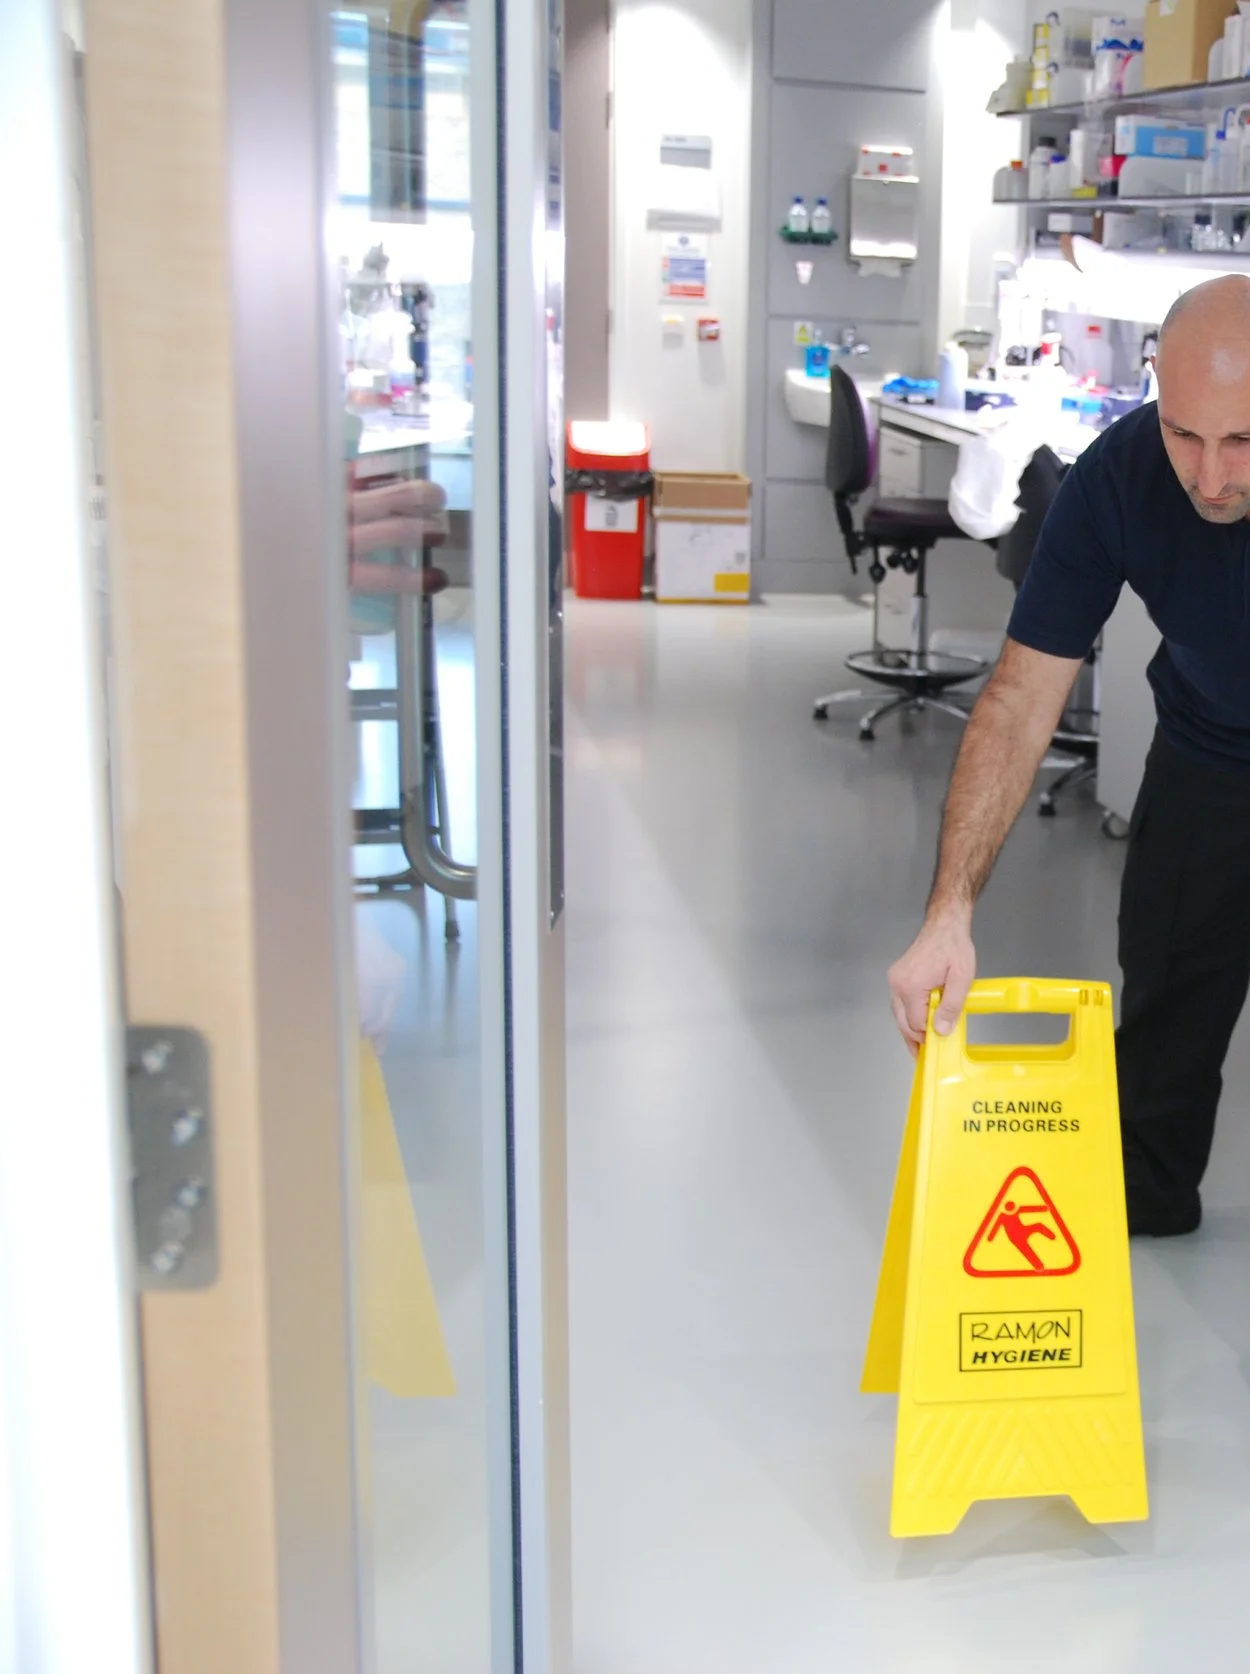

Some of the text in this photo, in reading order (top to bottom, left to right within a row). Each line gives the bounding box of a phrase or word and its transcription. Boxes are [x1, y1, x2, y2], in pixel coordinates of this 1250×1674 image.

[972, 1100, 1062, 1114] CLEANING
[963, 1119, 1080, 1132] IN PROGRESS
[971, 1316, 1071, 1344] RAMON
[972, 1348, 1072, 1364] HYGIENE
